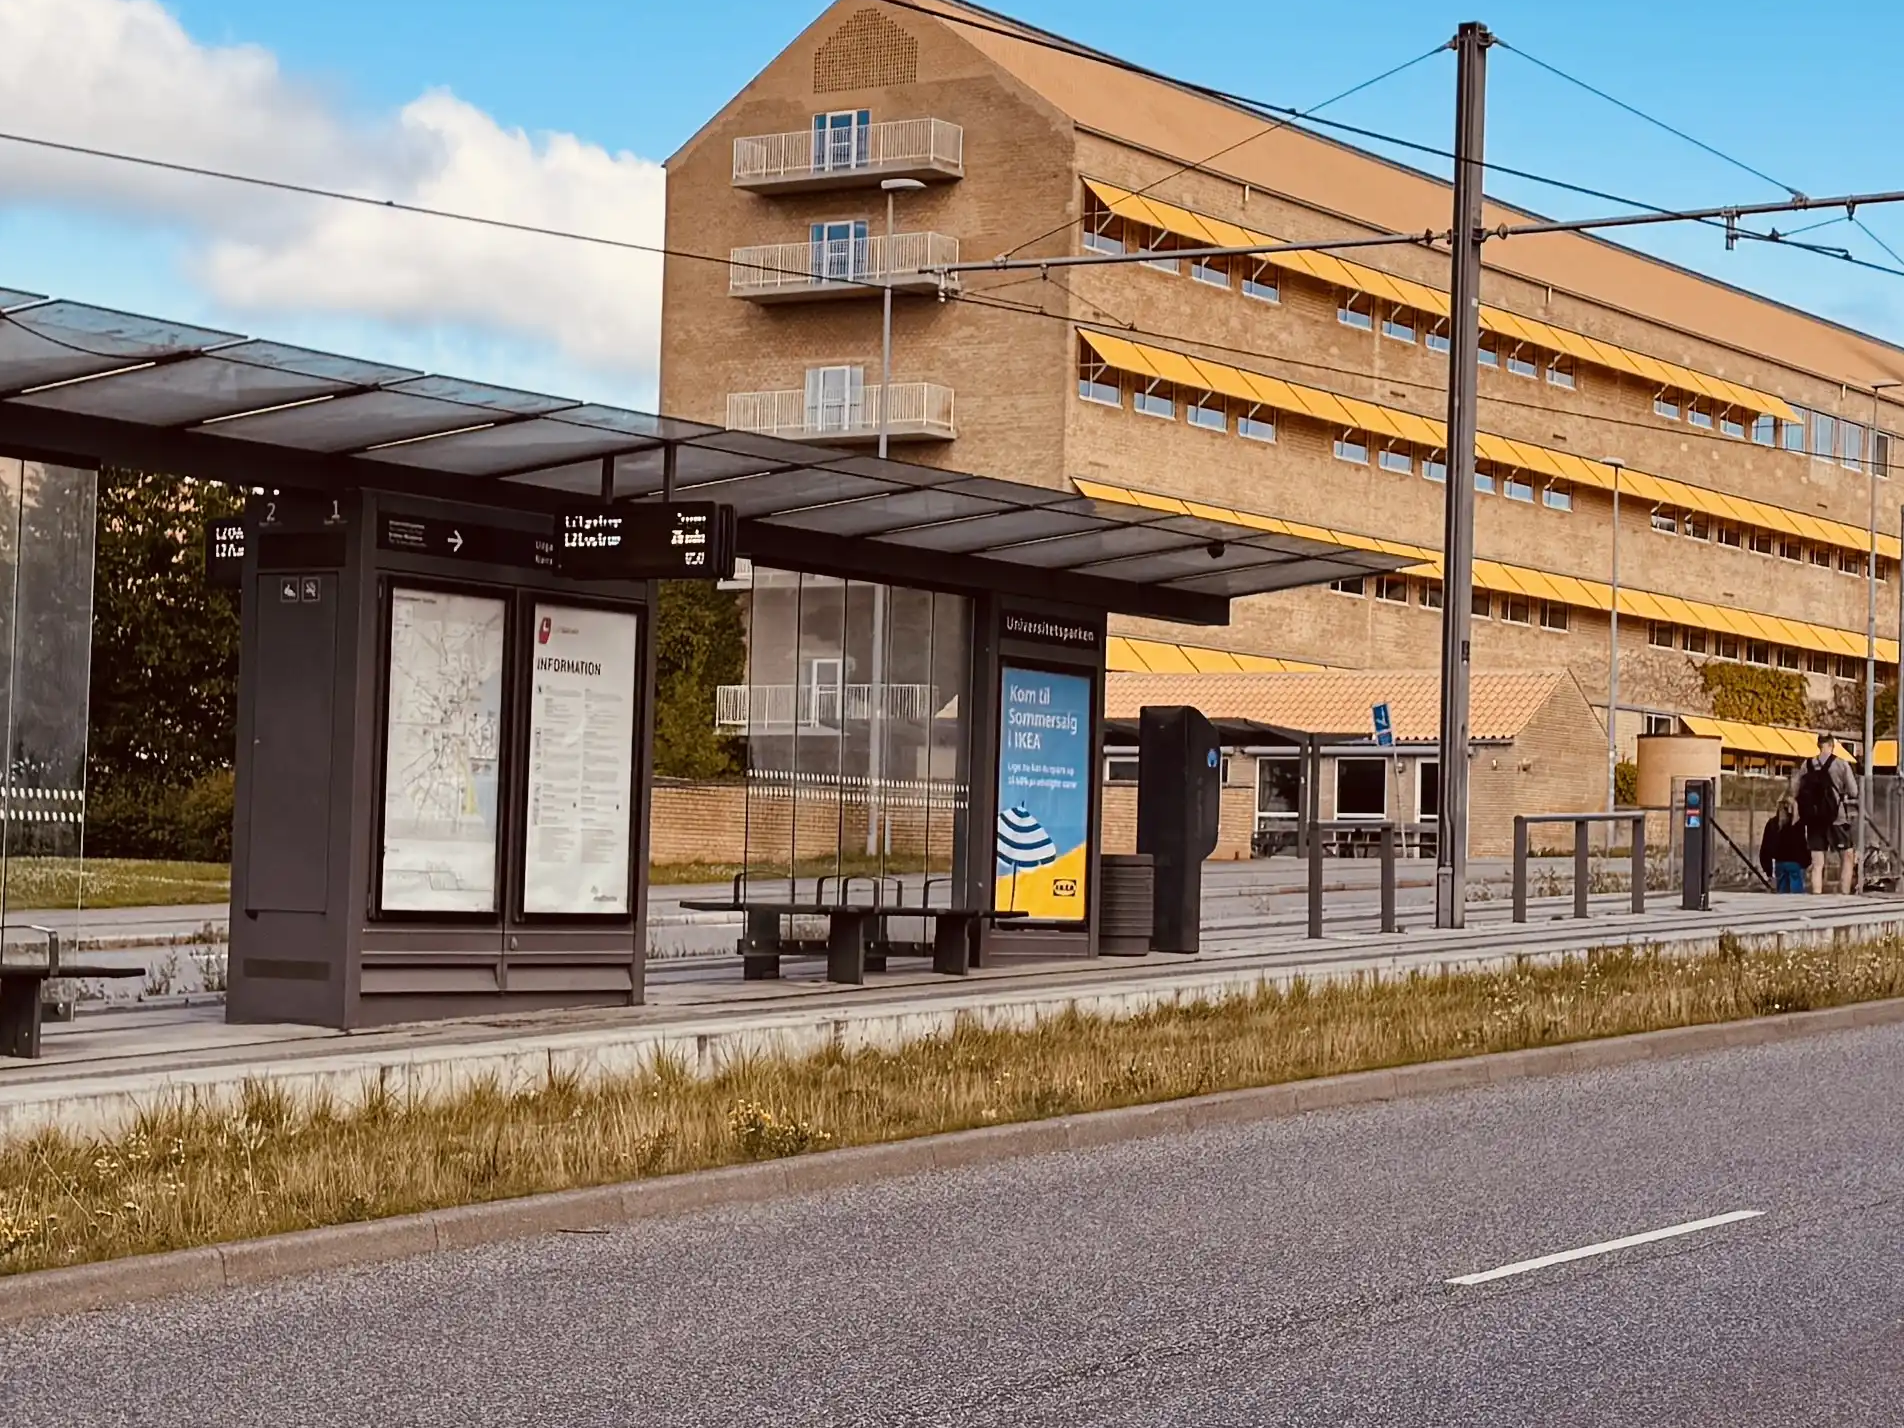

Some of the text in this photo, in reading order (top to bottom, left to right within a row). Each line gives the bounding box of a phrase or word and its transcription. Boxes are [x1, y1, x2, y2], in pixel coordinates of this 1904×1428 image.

[1006, 615, 1094, 641] Universitetsparken
[537, 657, 602, 676] INFORMATION
[1009, 684, 1050, 705] Kom til
[1009, 708, 1078, 735] Sommersalg
[1014, 731, 1041, 750] IKEA
